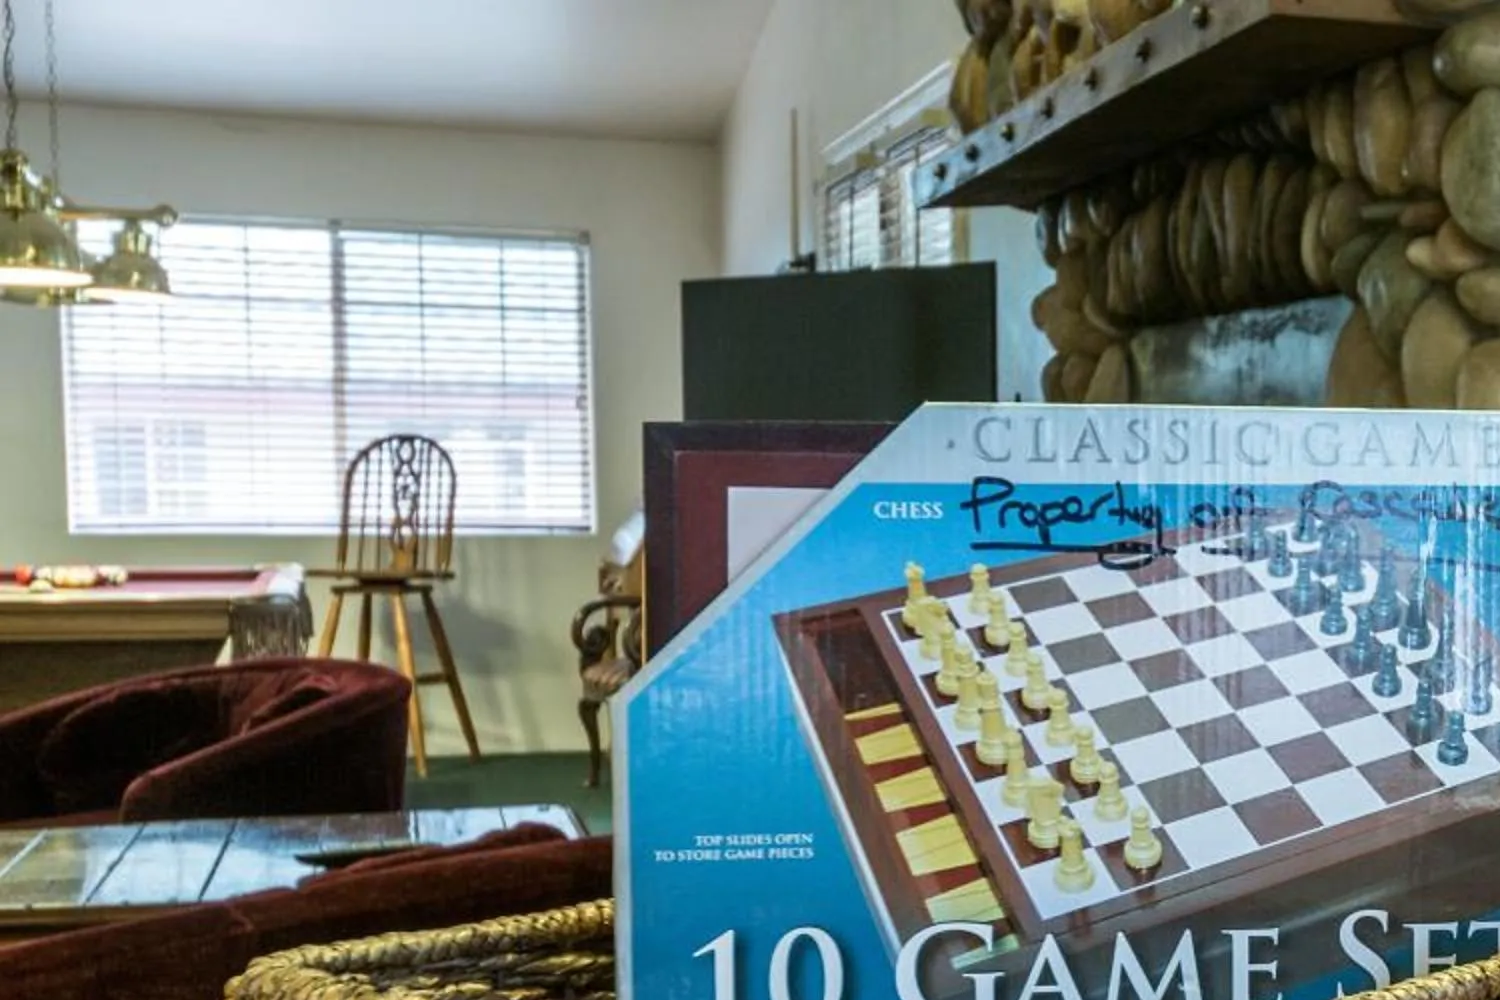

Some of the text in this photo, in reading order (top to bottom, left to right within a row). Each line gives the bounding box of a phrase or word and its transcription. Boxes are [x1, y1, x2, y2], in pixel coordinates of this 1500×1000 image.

[973, 415, 1271, 467] CLASSIC
[873, 501, 943, 520] CHESS
[695, 832, 814, 846] TOP SLIDES OPEN
[654, 847, 815, 862] TO STORE GAME PIECES
